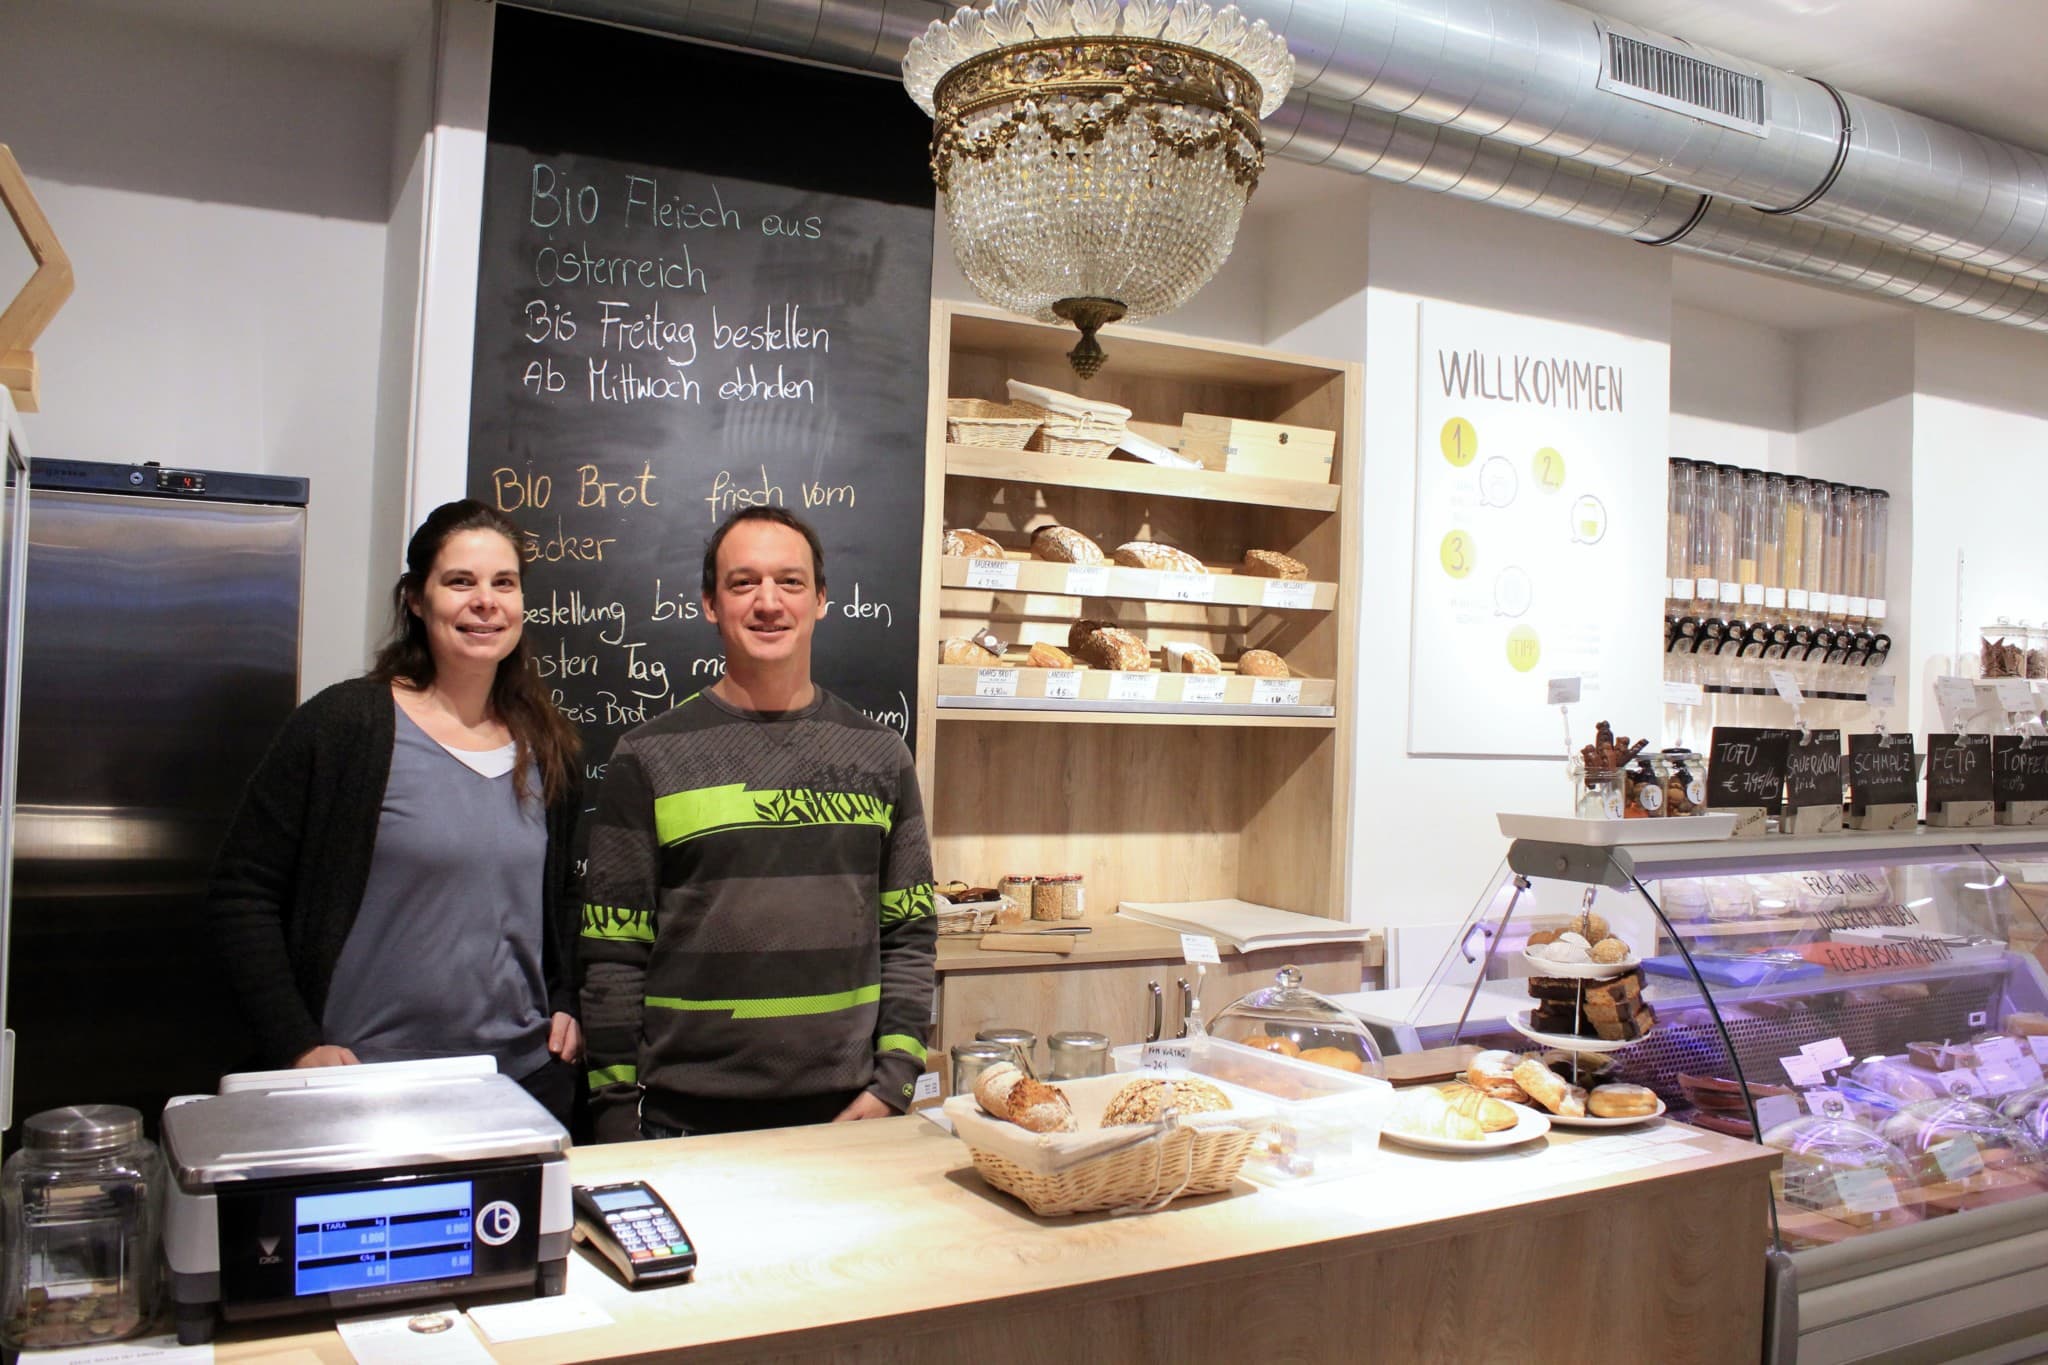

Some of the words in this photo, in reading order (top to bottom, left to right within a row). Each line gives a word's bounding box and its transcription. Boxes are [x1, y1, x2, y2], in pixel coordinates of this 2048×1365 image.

[625, 174, 741, 230] Fleisch
[761, 214, 823, 240] aus
[524, 299, 577, 344] Bis
[597, 299, 698, 367] Freitag
[712, 302, 830, 352] bestellen
[522, 357, 567, 394] Ab
[587, 356, 701, 404] Mittwoch
[1439, 348, 1623, 413] WILLKOMMEN
[1452, 423, 1467, 460] 1.
[577, 461, 658, 508] Brot
[704, 463, 784, 524] frisch
[802, 482, 856, 509] vom
[523, 514, 618, 562] äcker
[651, 578, 700, 622] bis
[843, 582, 893, 628] den
[622, 642, 670, 699] Tag
[1718, 742, 1758, 767] TOFU
[1854, 752, 1911, 775] SCHMALZ
[1931, 746, 1977, 775] FETA
[1721, 773, 1739, 793] €
[1803, 875, 1842, 897] FRAG
[1842, 871, 1879, 895] NACH
[1814, 906, 1877, 933] UNSEREM
[1877, 904, 1921, 928] NEUEN
[1824, 934, 1954, 974] FLEISCHSORTIMENT!
[325, 1221, 347, 1231] TARA
